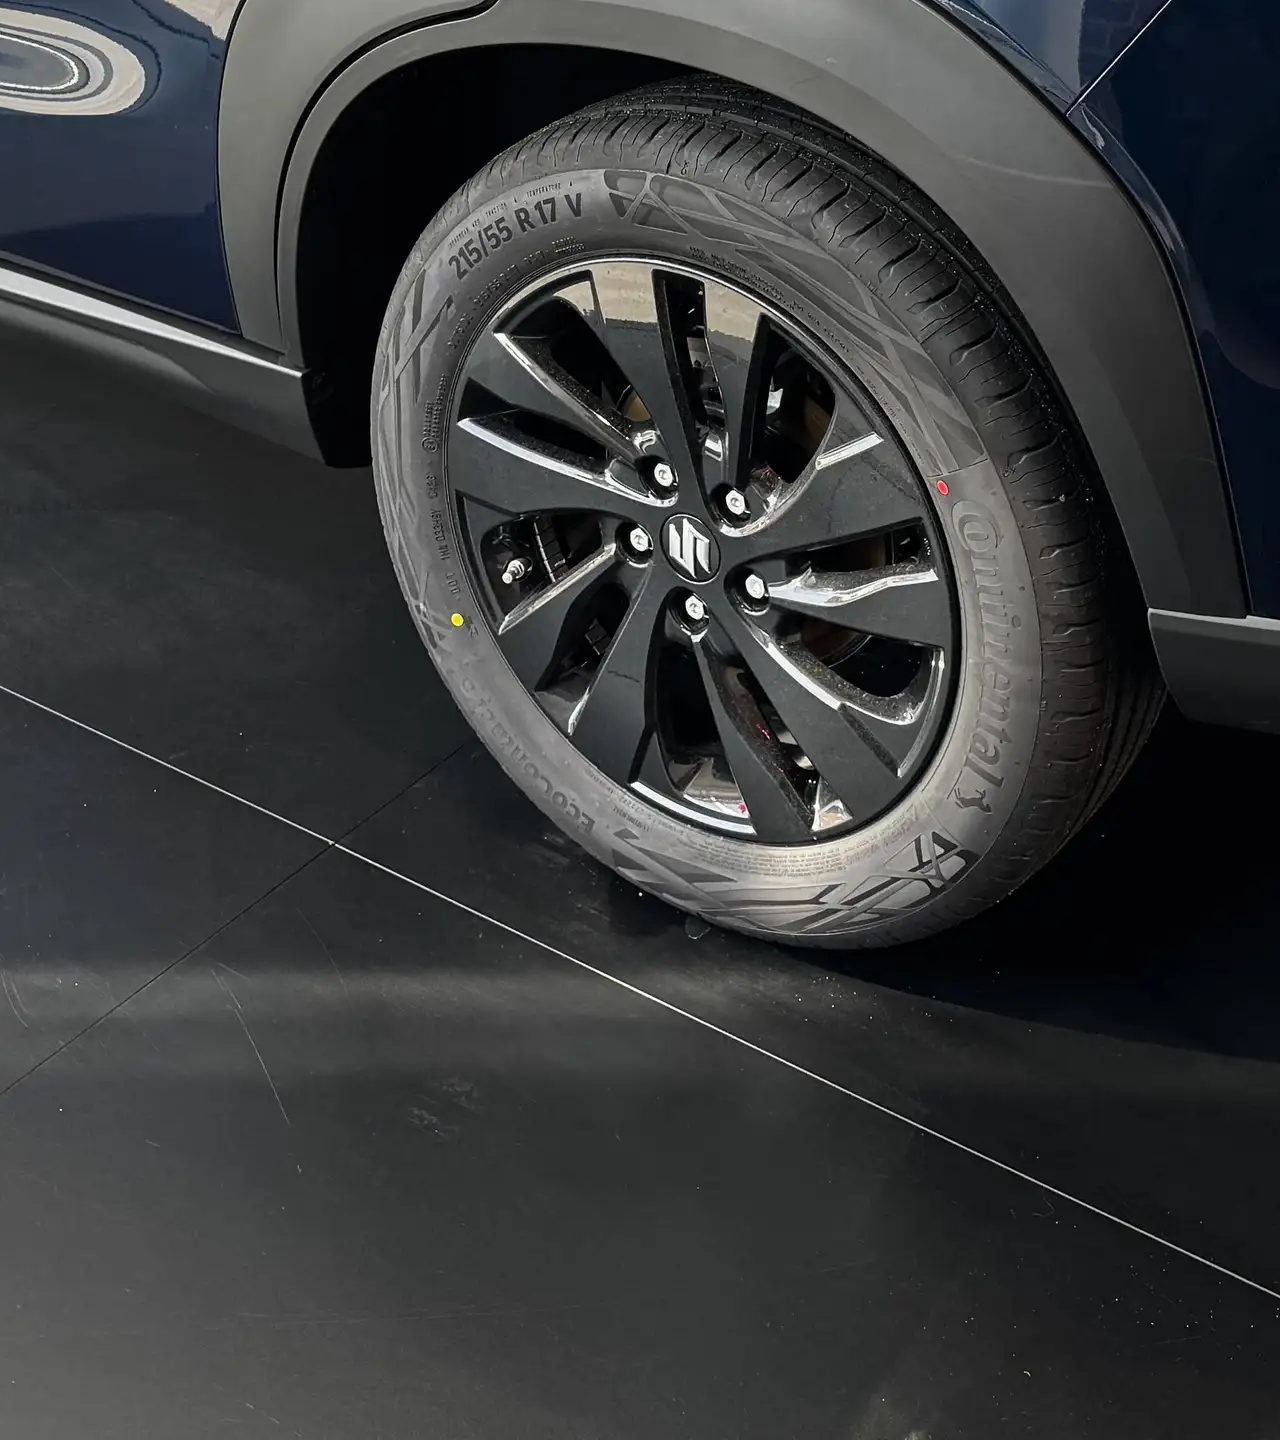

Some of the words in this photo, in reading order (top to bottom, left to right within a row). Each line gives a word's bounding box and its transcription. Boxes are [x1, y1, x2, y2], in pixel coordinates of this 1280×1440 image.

[448, 216, 513, 280] 215/55
[514, 207, 537, 234] R
[533, 196, 557, 225] 17
[563, 192, 582, 218] V
[951, 499, 1019, 790] Continental
